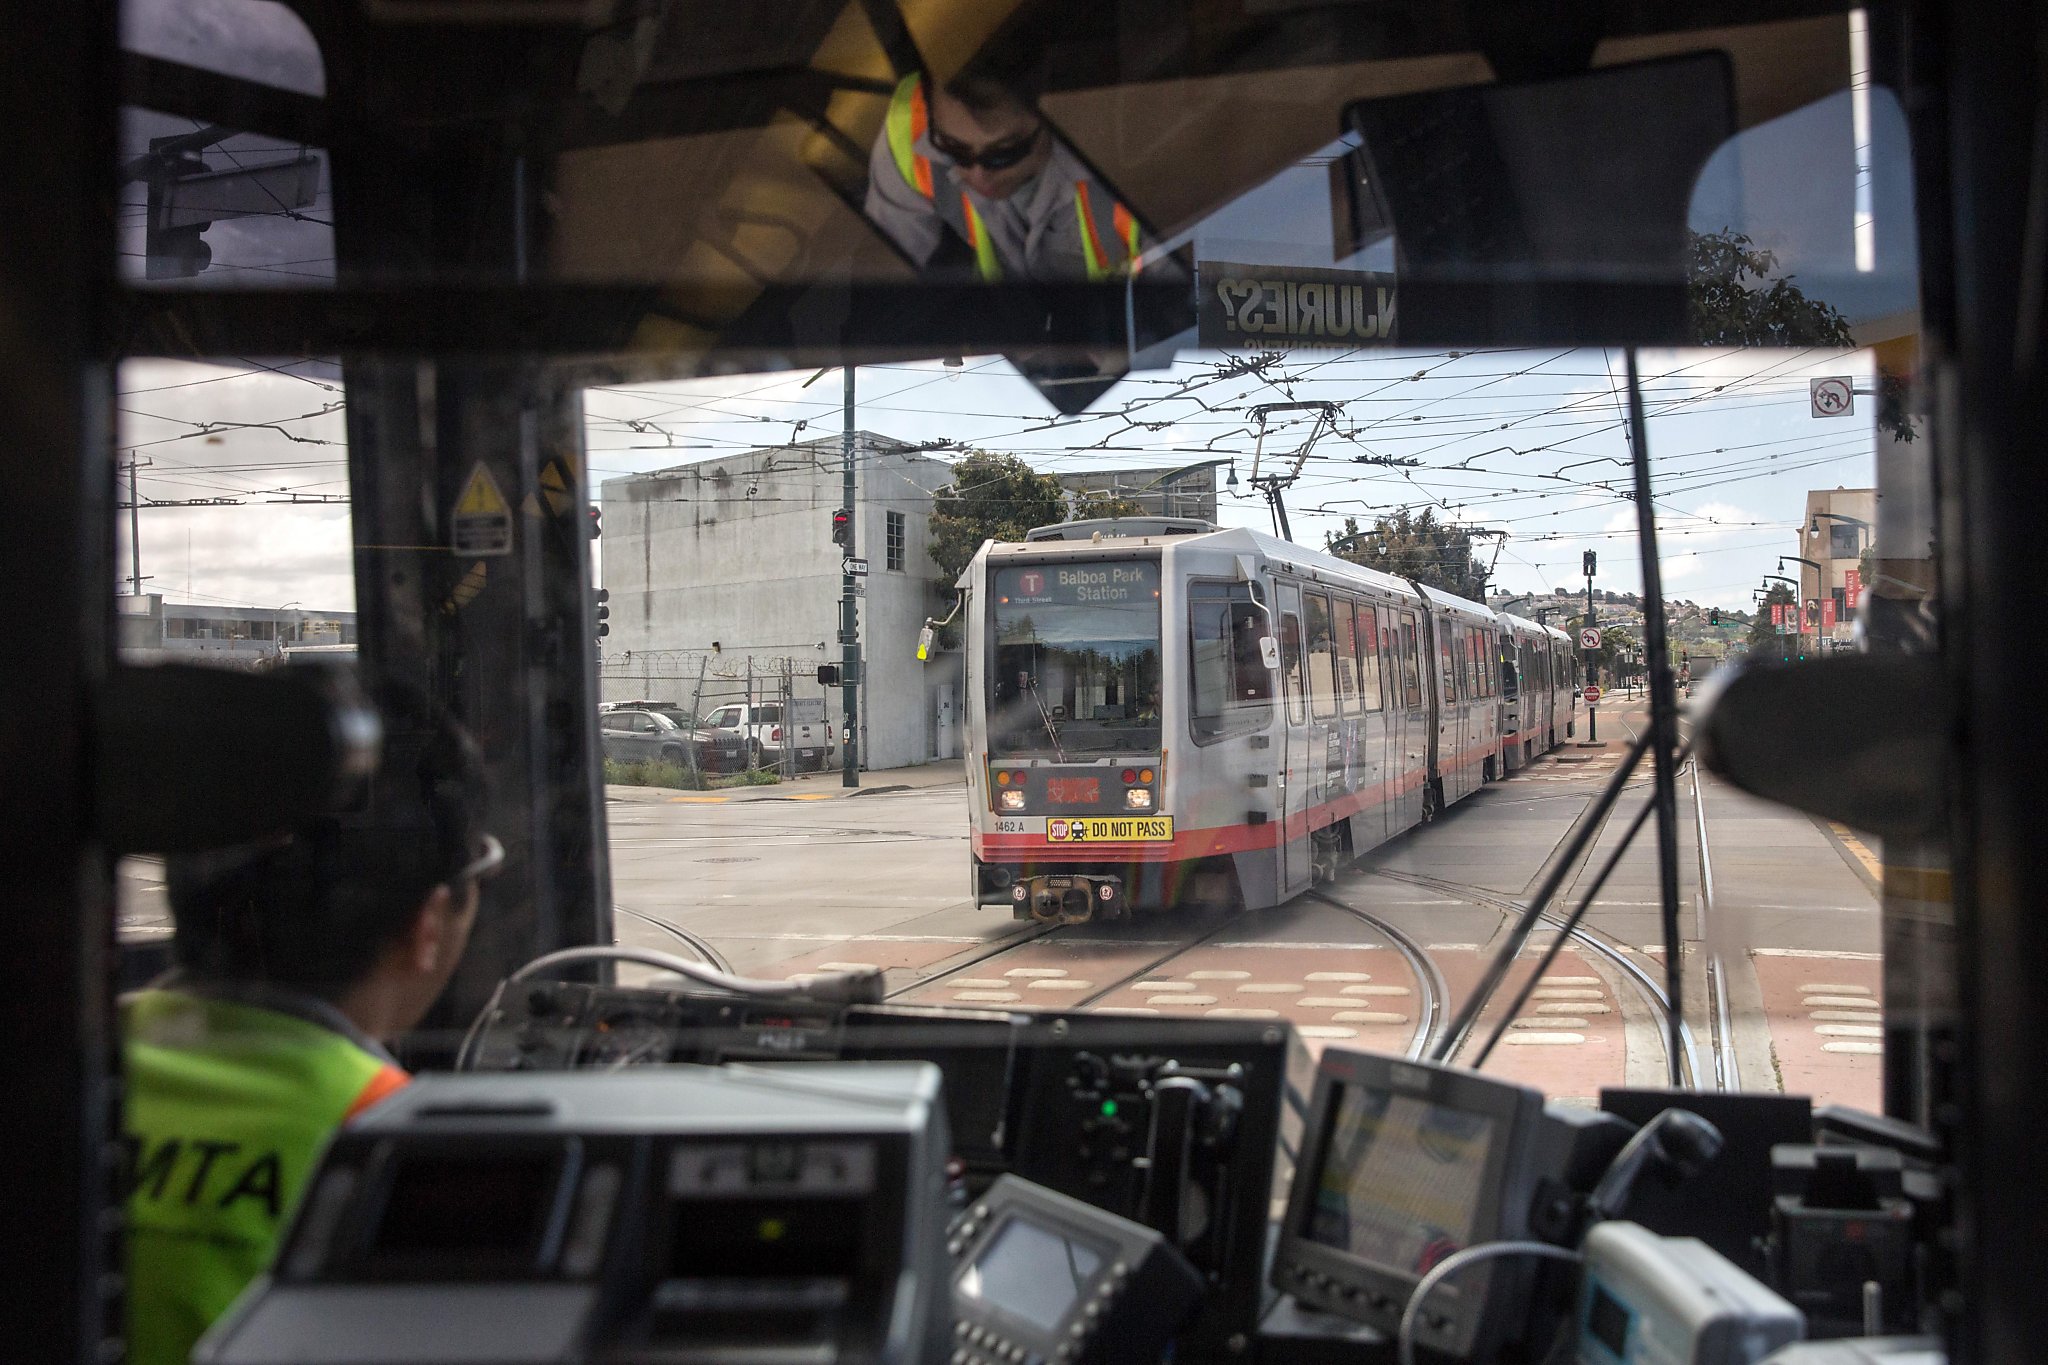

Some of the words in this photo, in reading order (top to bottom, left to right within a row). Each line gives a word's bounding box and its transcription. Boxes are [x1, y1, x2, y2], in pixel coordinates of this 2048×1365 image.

[1025, 575, 1039, 592] T
[1059, 570, 1107, 585] Balboa
[1113, 568, 1144, 583] Park
[1077, 586, 1128, 601] Station
[995, 821, 1015, 832] 1462
[1018, 823, 1025, 832] A
[1051, 824, 1068, 837] STOP
[1092, 822, 1107, 837] DO
[1111, 822, 1134, 837] NOT
[1137, 821, 1166, 837] PASS
